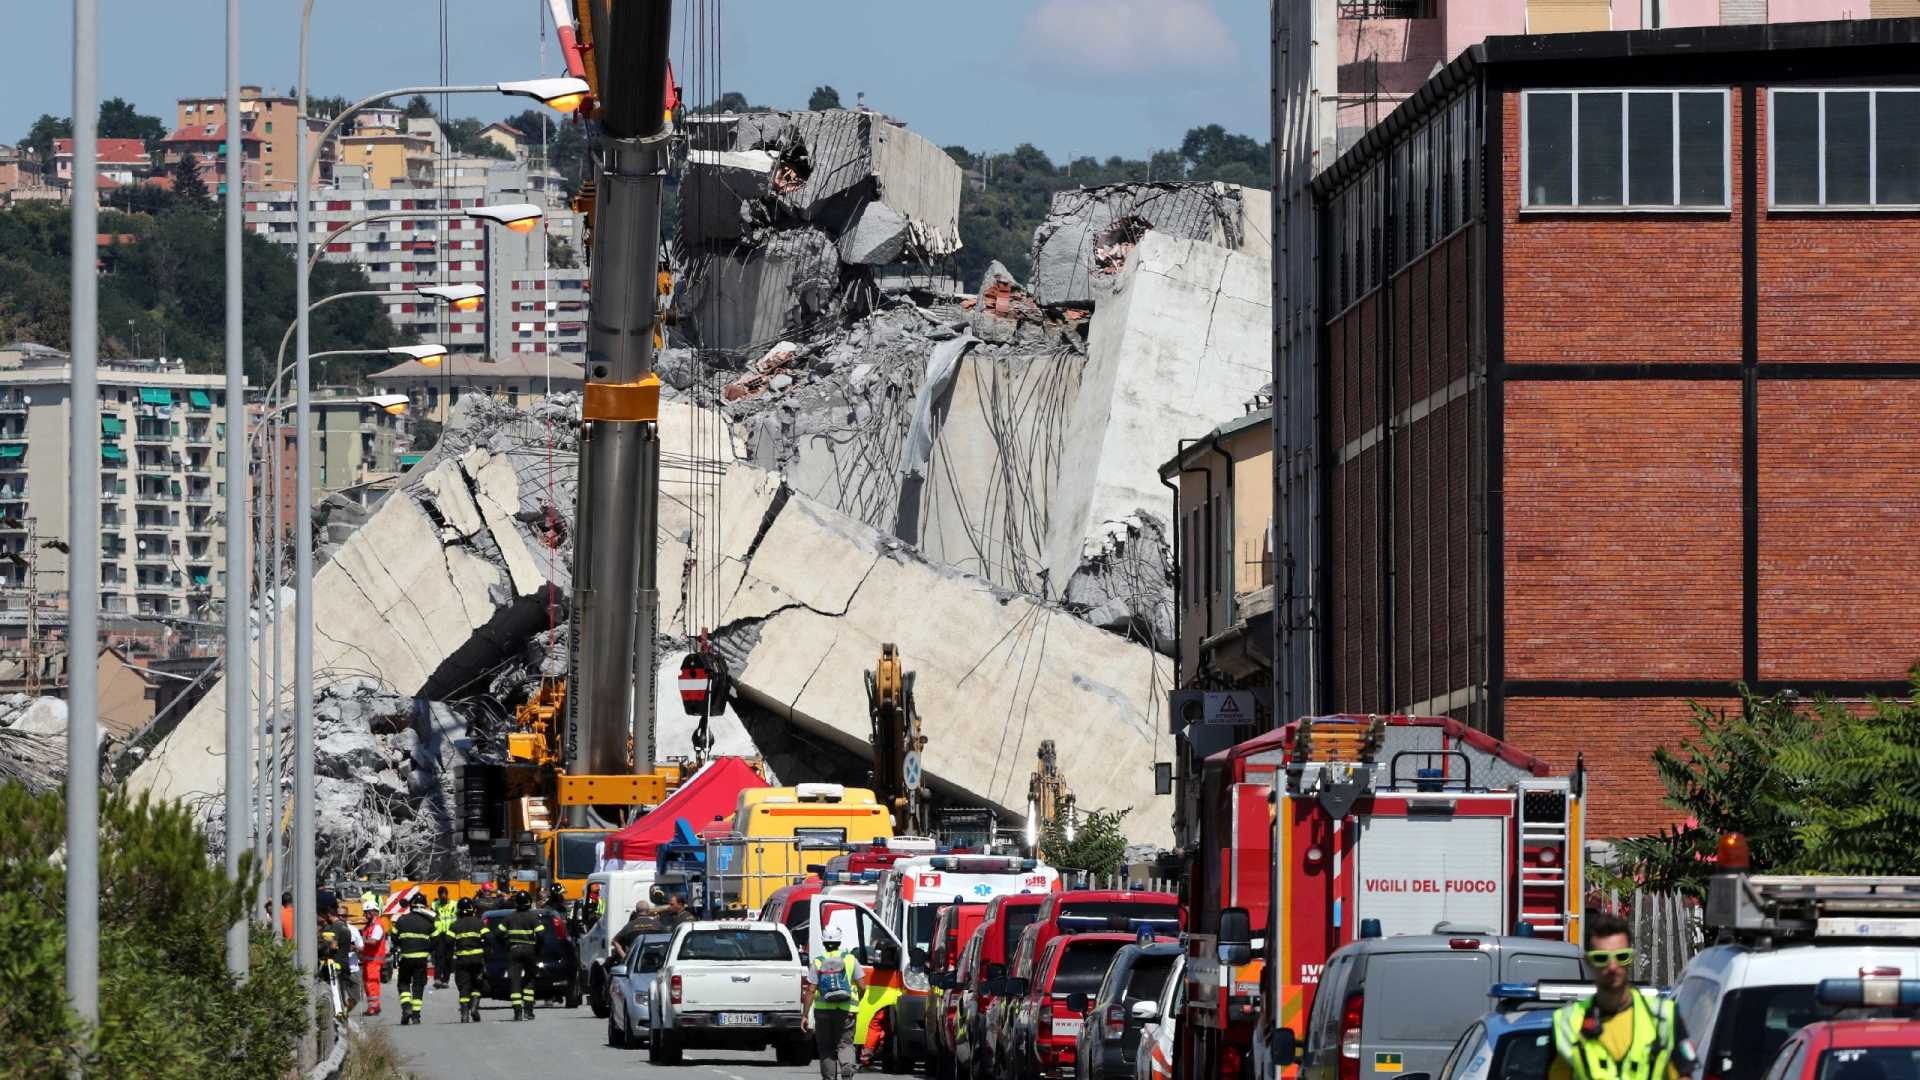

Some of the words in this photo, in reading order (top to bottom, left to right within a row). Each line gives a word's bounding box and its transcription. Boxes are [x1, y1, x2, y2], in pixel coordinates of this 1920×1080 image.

[1366, 879, 1408, 892] VIGILI
[1412, 879, 1440, 893] DEL
[1445, 879, 1496, 893] FUOCO
